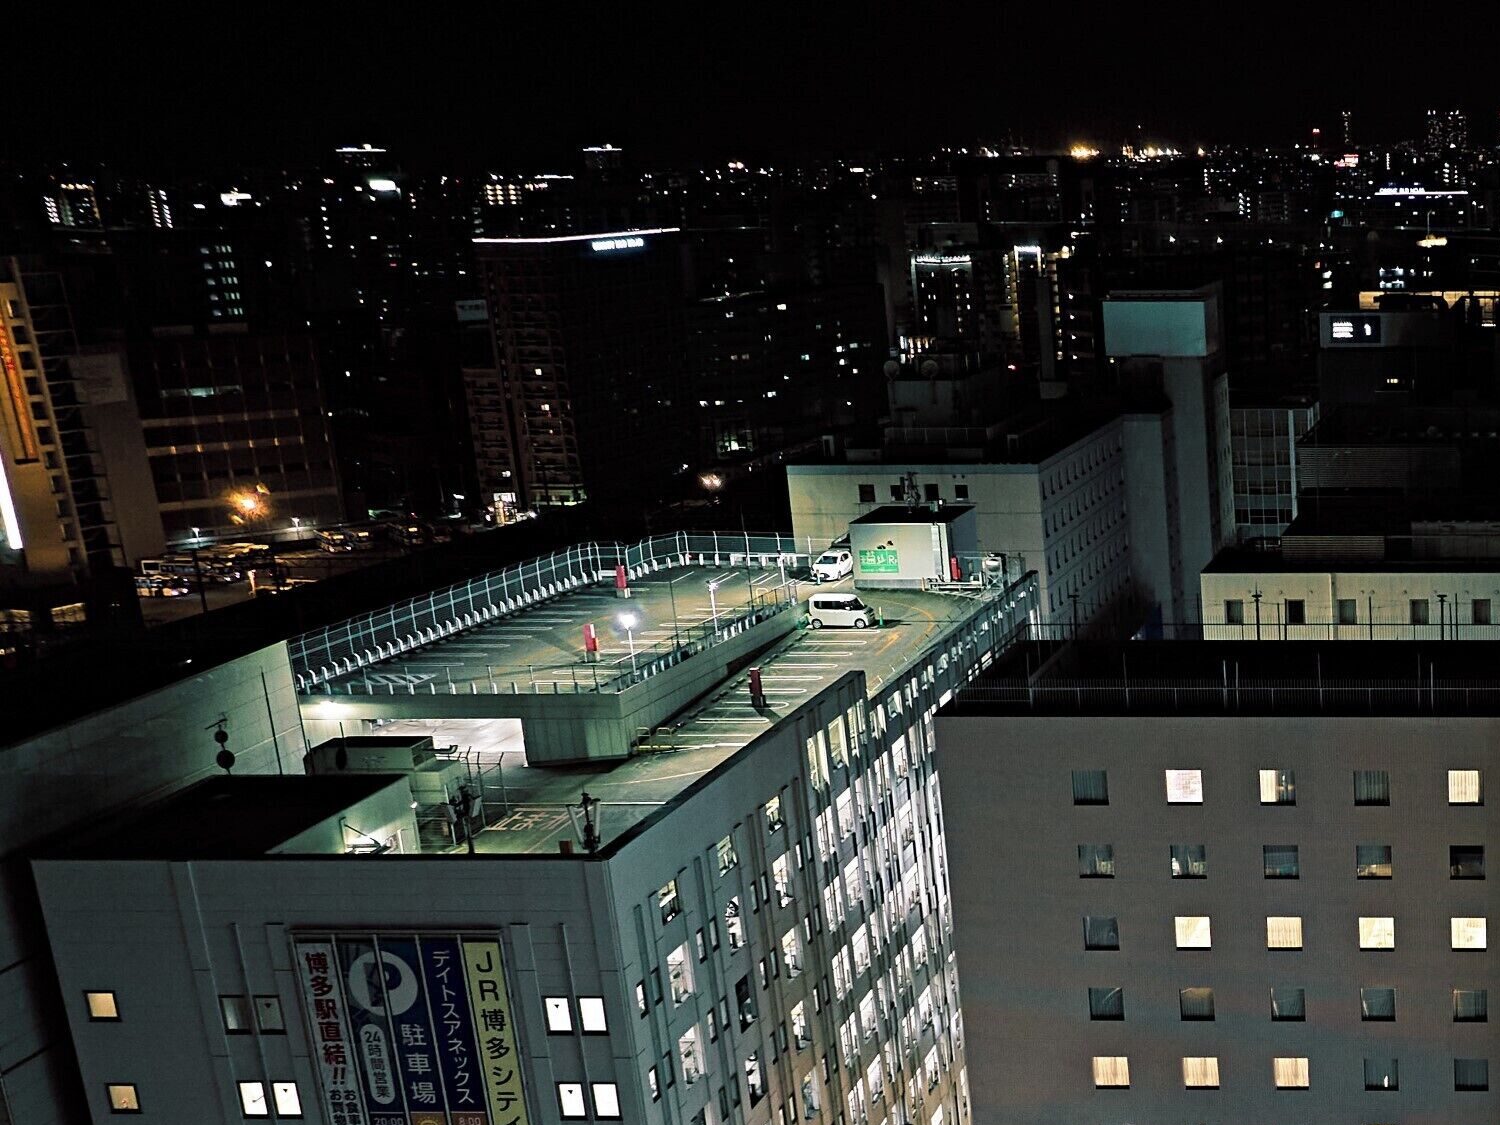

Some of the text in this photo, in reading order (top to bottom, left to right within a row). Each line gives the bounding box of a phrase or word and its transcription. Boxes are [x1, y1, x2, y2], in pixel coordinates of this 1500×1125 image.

[363, 1029, 391, 1099] 24時間営業
[400, 1023, 437, 1105] 駐車場
[432, 950, 474, 1105] デイトスアネックス
